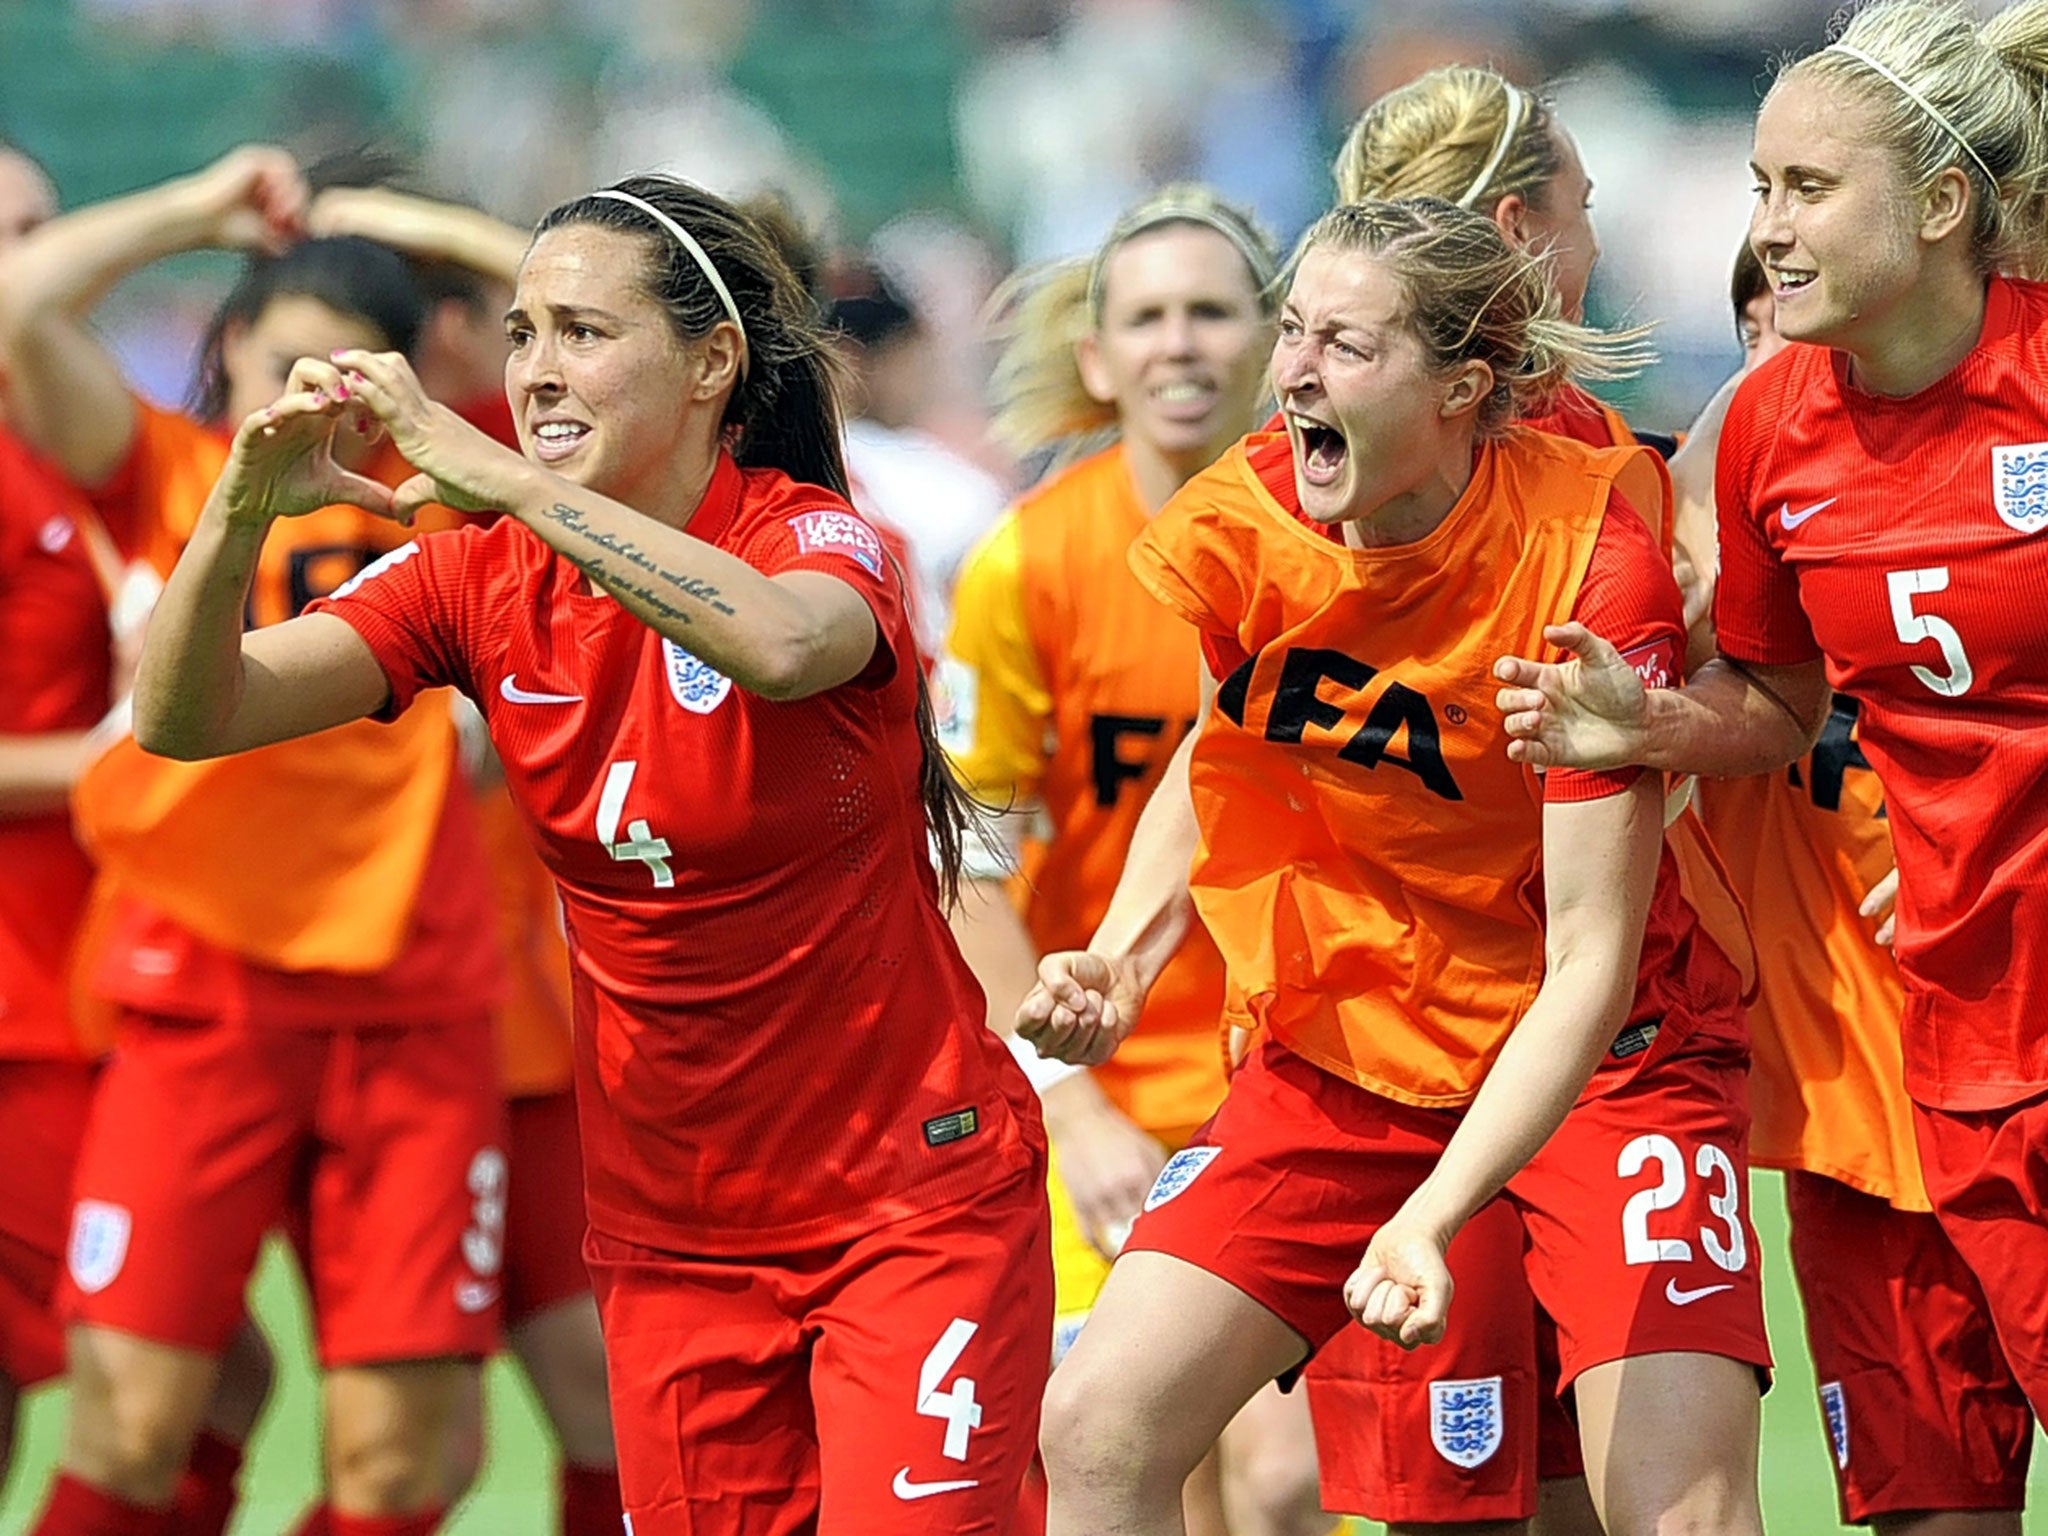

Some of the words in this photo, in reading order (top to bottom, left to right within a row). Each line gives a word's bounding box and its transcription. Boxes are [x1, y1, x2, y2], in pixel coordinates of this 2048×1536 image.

[541, 502, 588, 534] That
[584, 522, 635, 556] which
[626, 551, 657, 573] does
[680, 578, 720, 602] kill
[711, 600, 736, 617] me
[609, 574, 634, 591] me
[632, 587, 692, 625] stronger
[809, 531, 877, 556] GOALS
[1886, 566, 1973, 696] 5
[595, 760, 675, 888] 4
[1617, 1133, 1747, 1273] 23
[916, 1317, 983, 1462] 4
